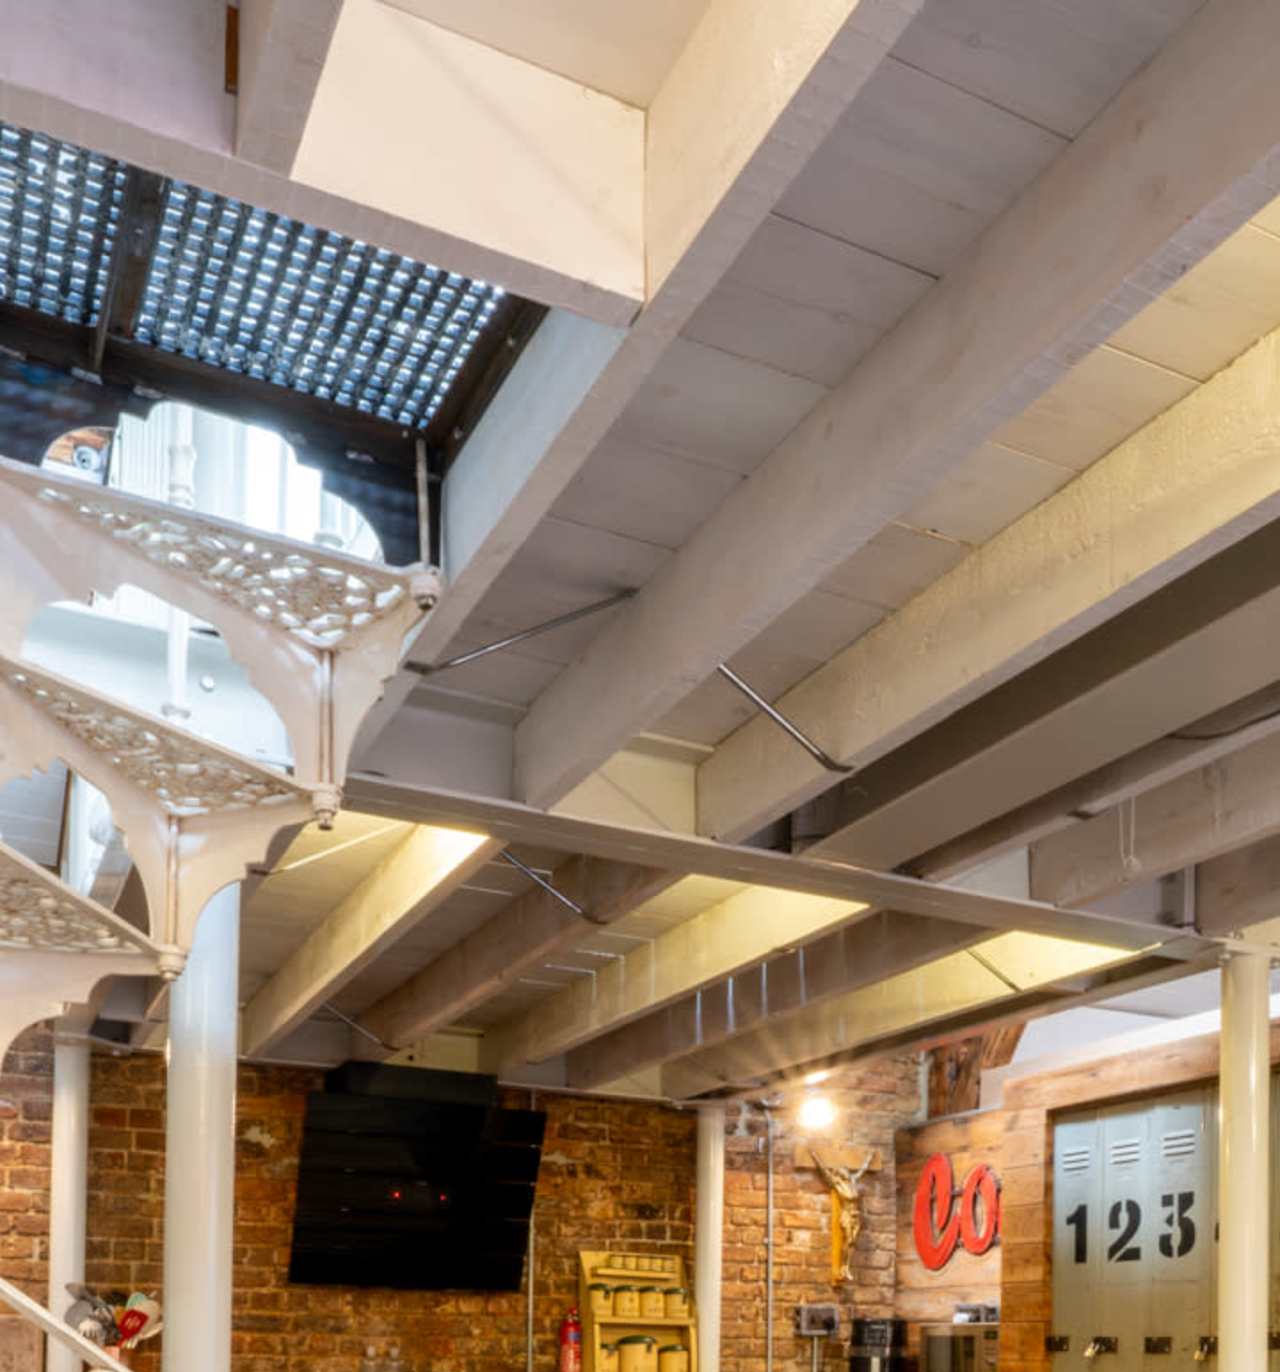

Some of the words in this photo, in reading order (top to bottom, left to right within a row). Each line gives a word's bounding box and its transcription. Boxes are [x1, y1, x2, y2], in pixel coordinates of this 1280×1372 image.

[1066, 1204, 1088, 1264] 1
[1108, 1199, 1142, 1263] 2
[1158, 1191, 1196, 1258] 3
